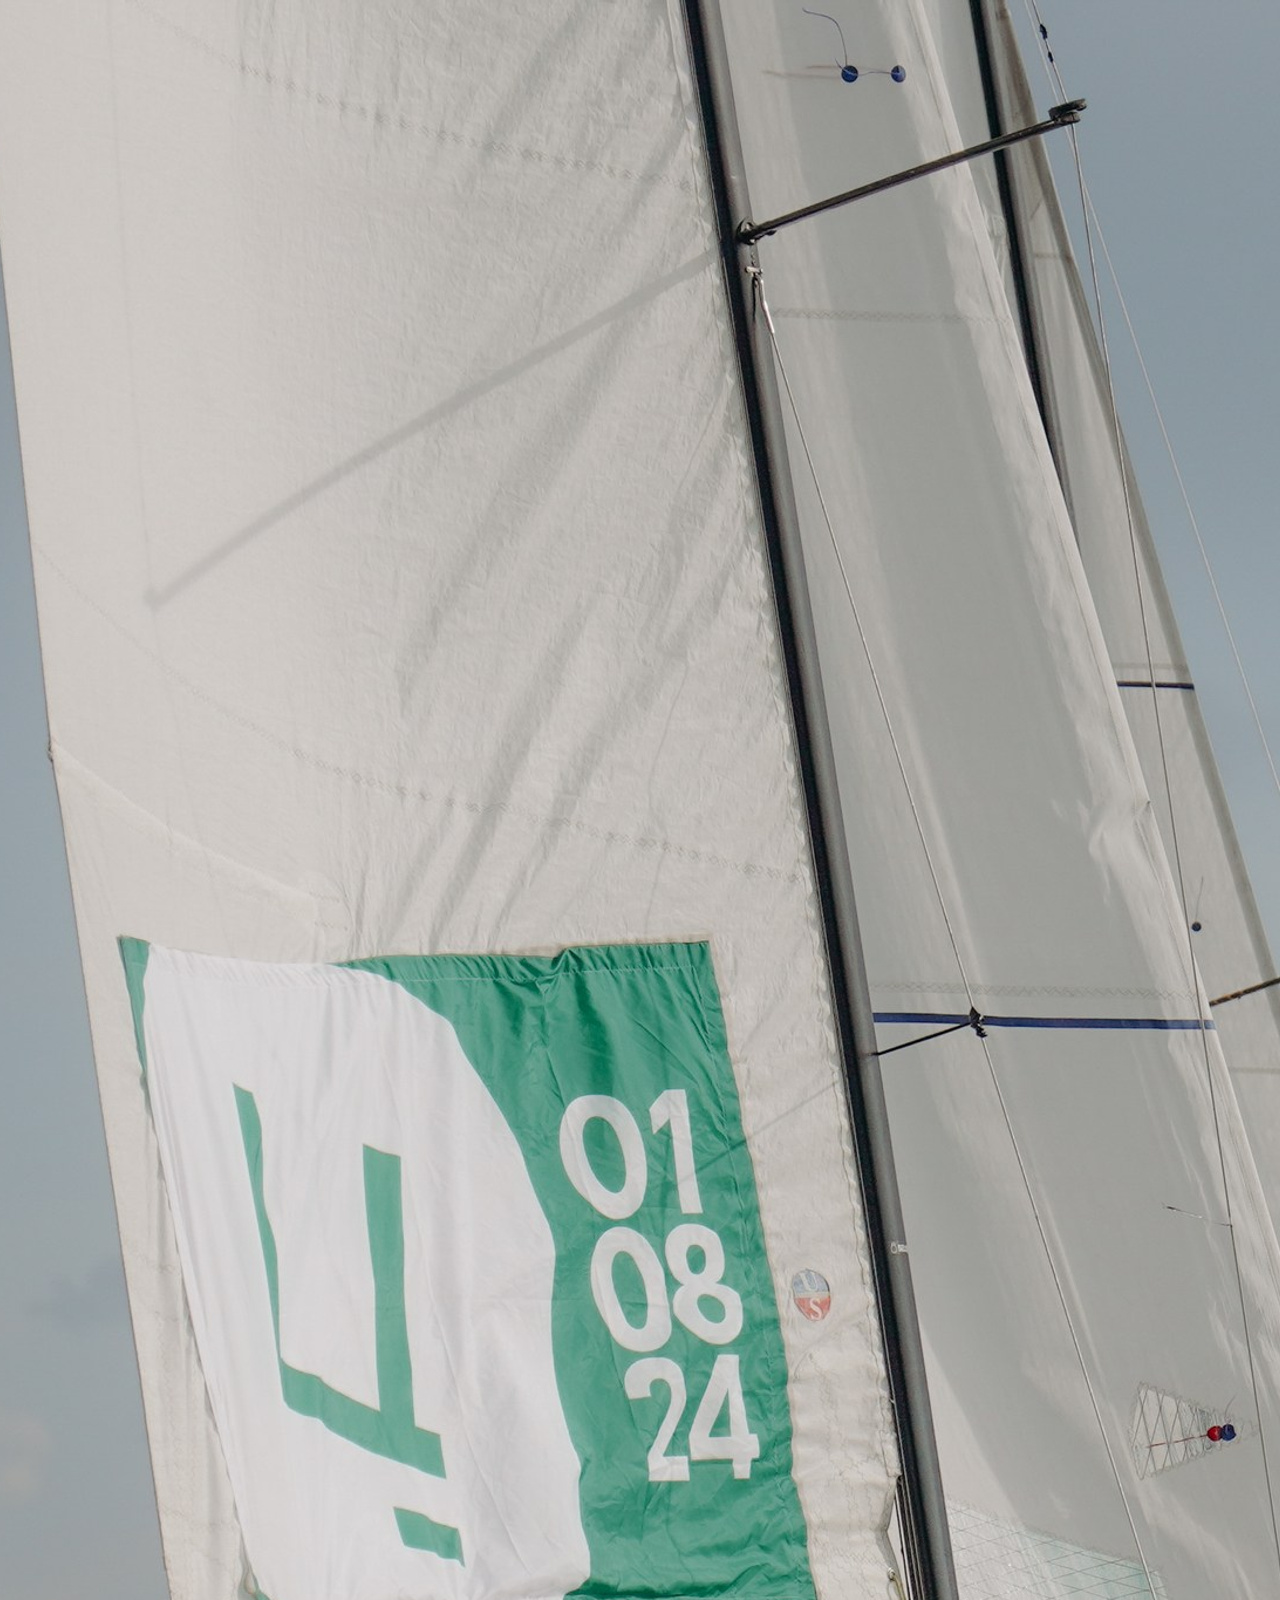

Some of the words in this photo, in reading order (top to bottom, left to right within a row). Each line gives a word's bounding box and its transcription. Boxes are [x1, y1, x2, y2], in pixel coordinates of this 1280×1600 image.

[559, 1089, 703, 1220] 01
[591, 1223, 743, 1352] 08
[624, 1354, 760, 1482] 24
